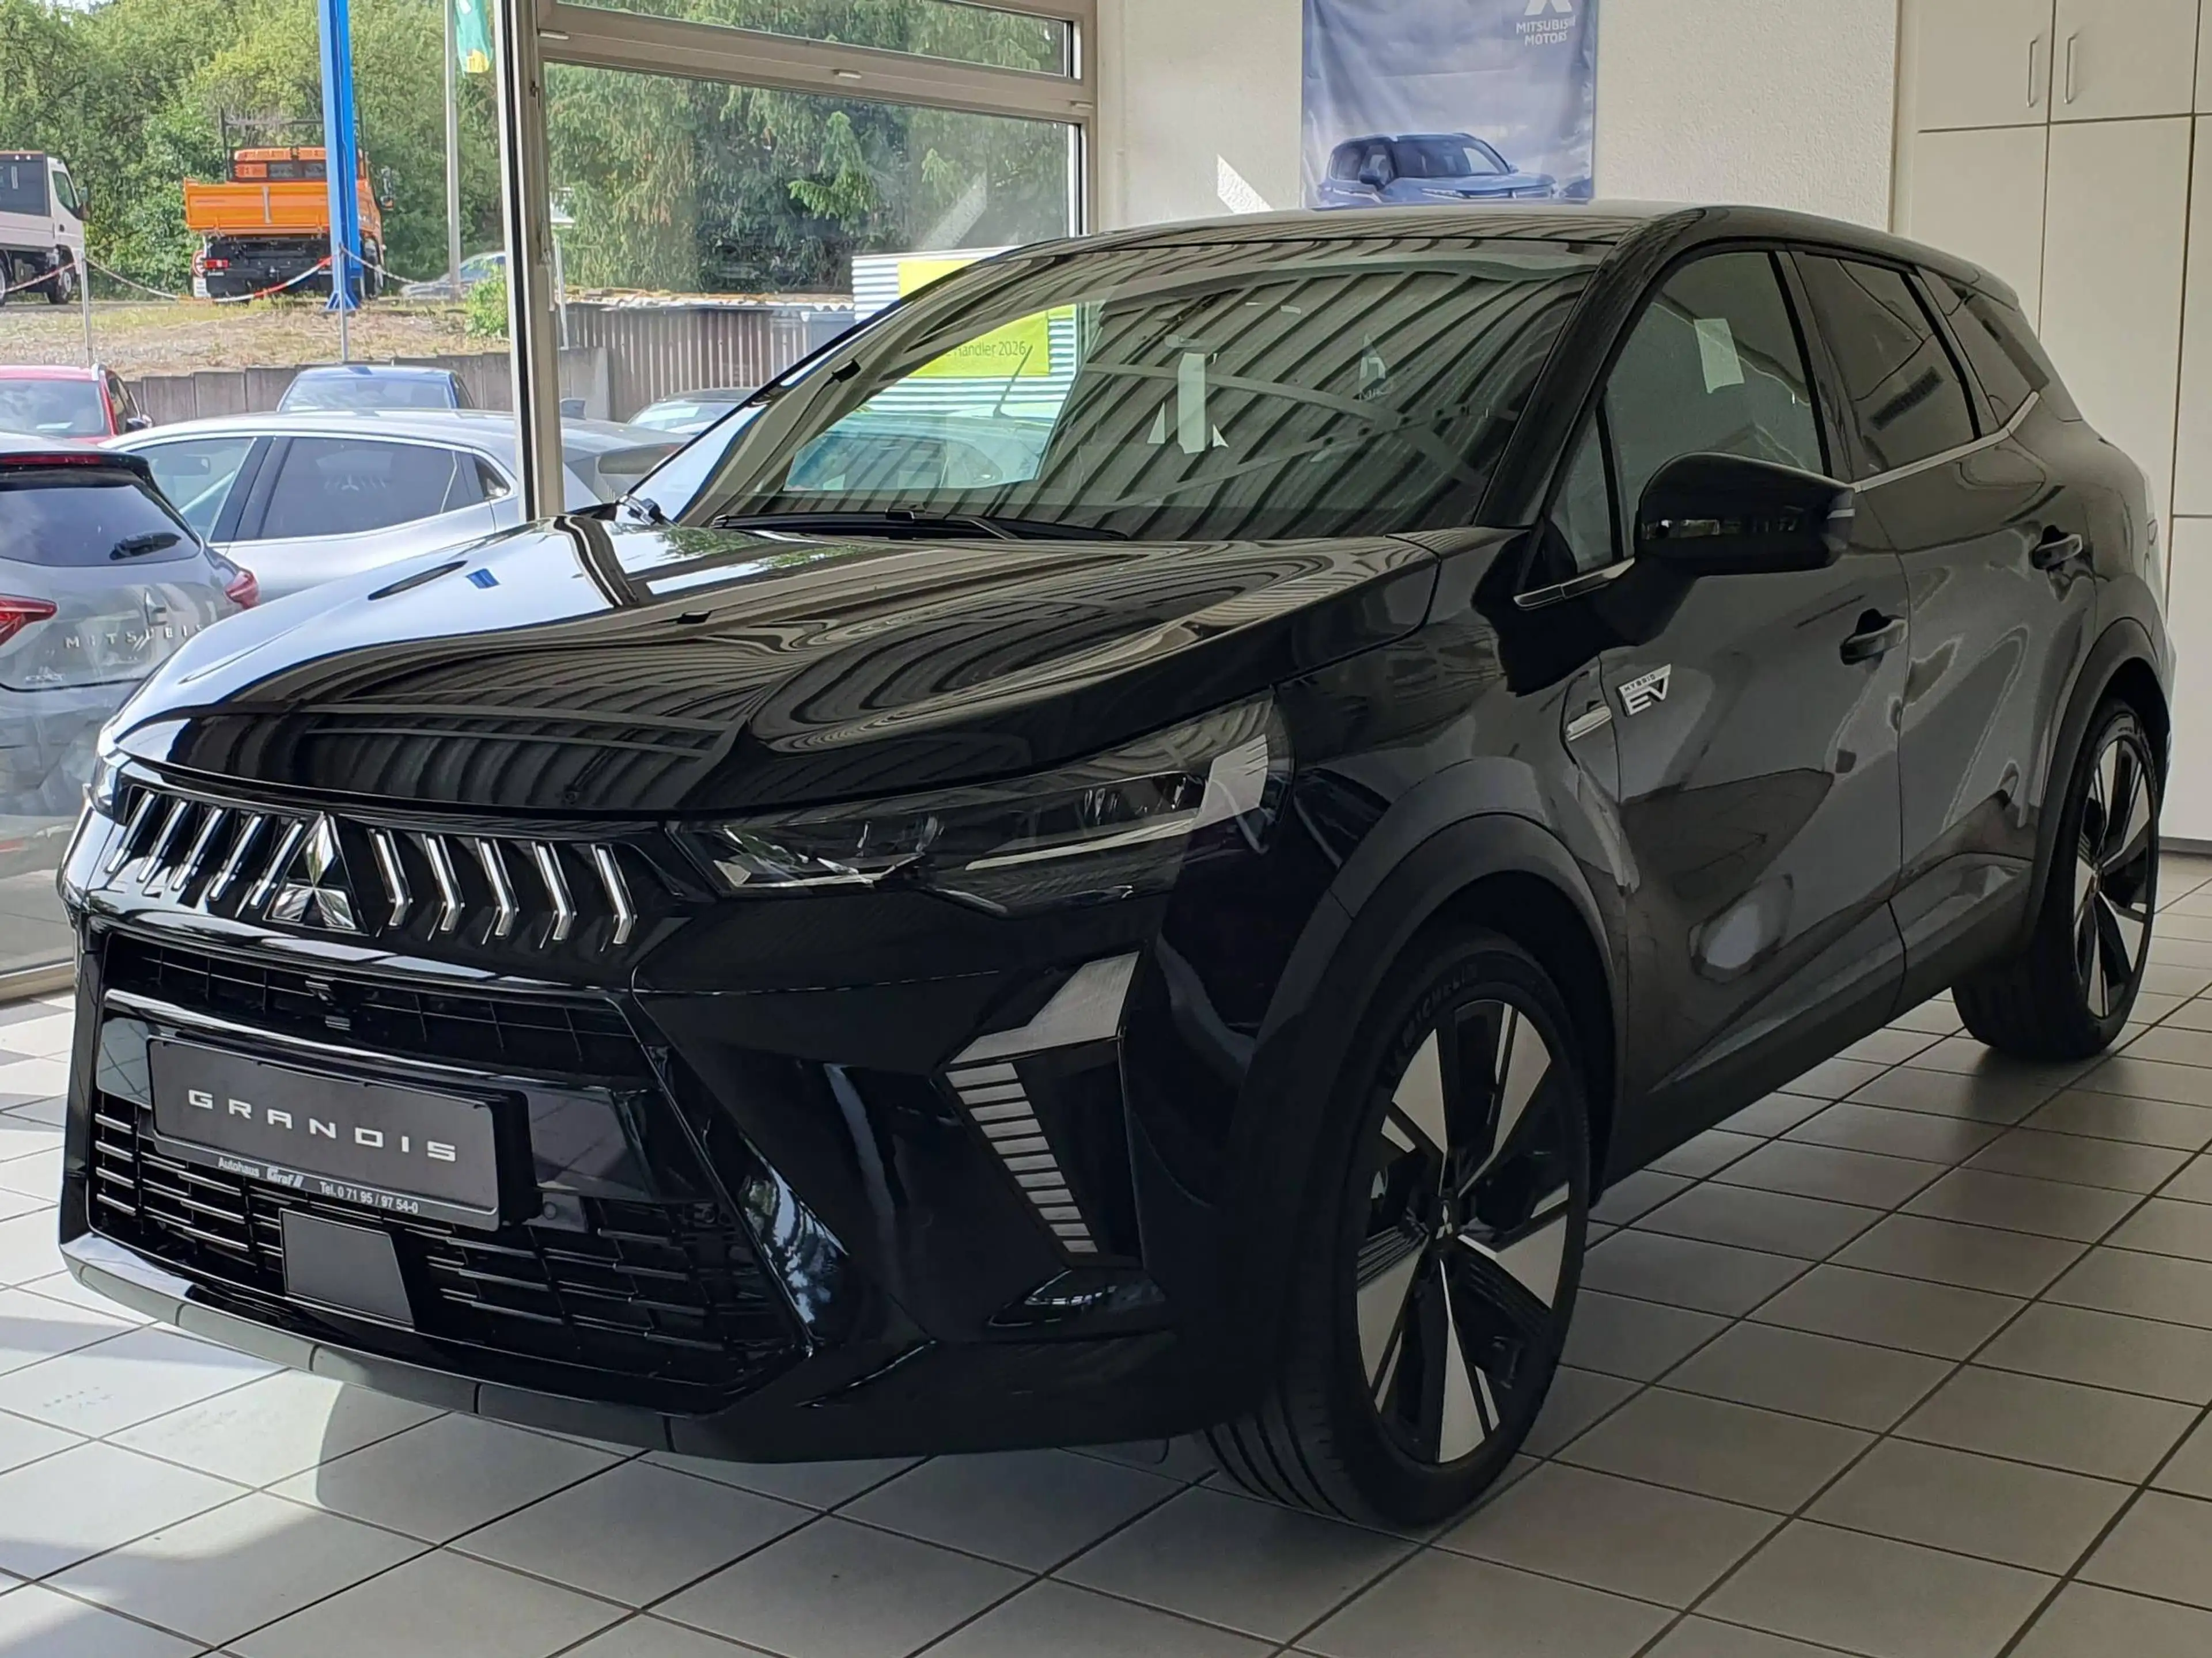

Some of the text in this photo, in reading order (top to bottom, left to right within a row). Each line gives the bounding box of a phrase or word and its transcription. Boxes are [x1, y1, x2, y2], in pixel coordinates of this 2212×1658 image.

[998, 341, 1027, 356] 2026
[1624, 674, 1656, 692] HYBRID
[1624, 670, 1670, 715] EV
[188, 1089, 456, 1162] GRANDIS
[218, 1156, 260, 1177] Autohaus
[319, 1181, 336, 1197] Tel.
[338, 1186, 344, 1198] 0
[347, 1188, 357, 1201] 71
[360, 1191, 373, 1204] 95
[381, 1196, 394, 1208] 97
[396, 1198, 418, 1215] 54-0
